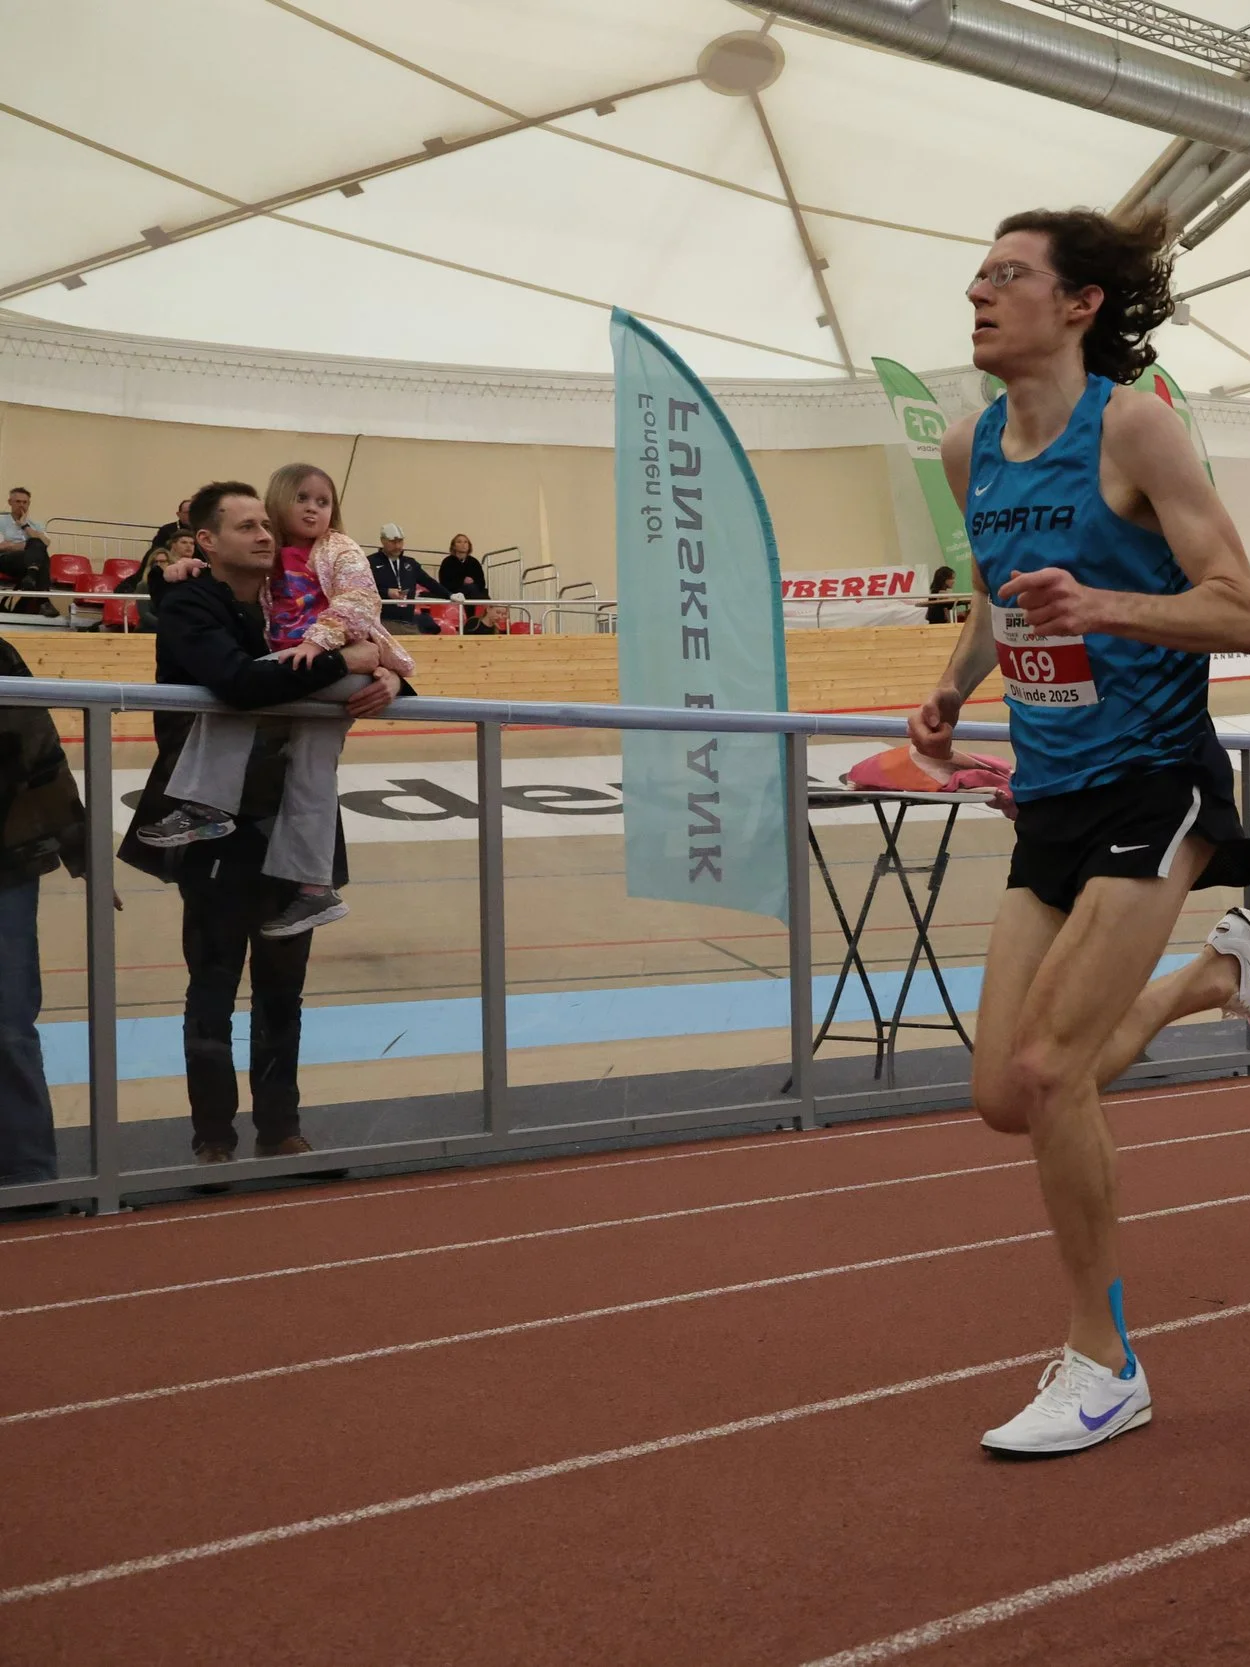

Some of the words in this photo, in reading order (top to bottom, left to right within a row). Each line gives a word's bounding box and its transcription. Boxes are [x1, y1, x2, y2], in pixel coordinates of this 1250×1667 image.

[971, 505, 1076, 537] SPARTA
[1009, 650, 1056, 682] 169
[1023, 687, 1047, 703] inde
[1049, 688, 1080, 703] 2025
